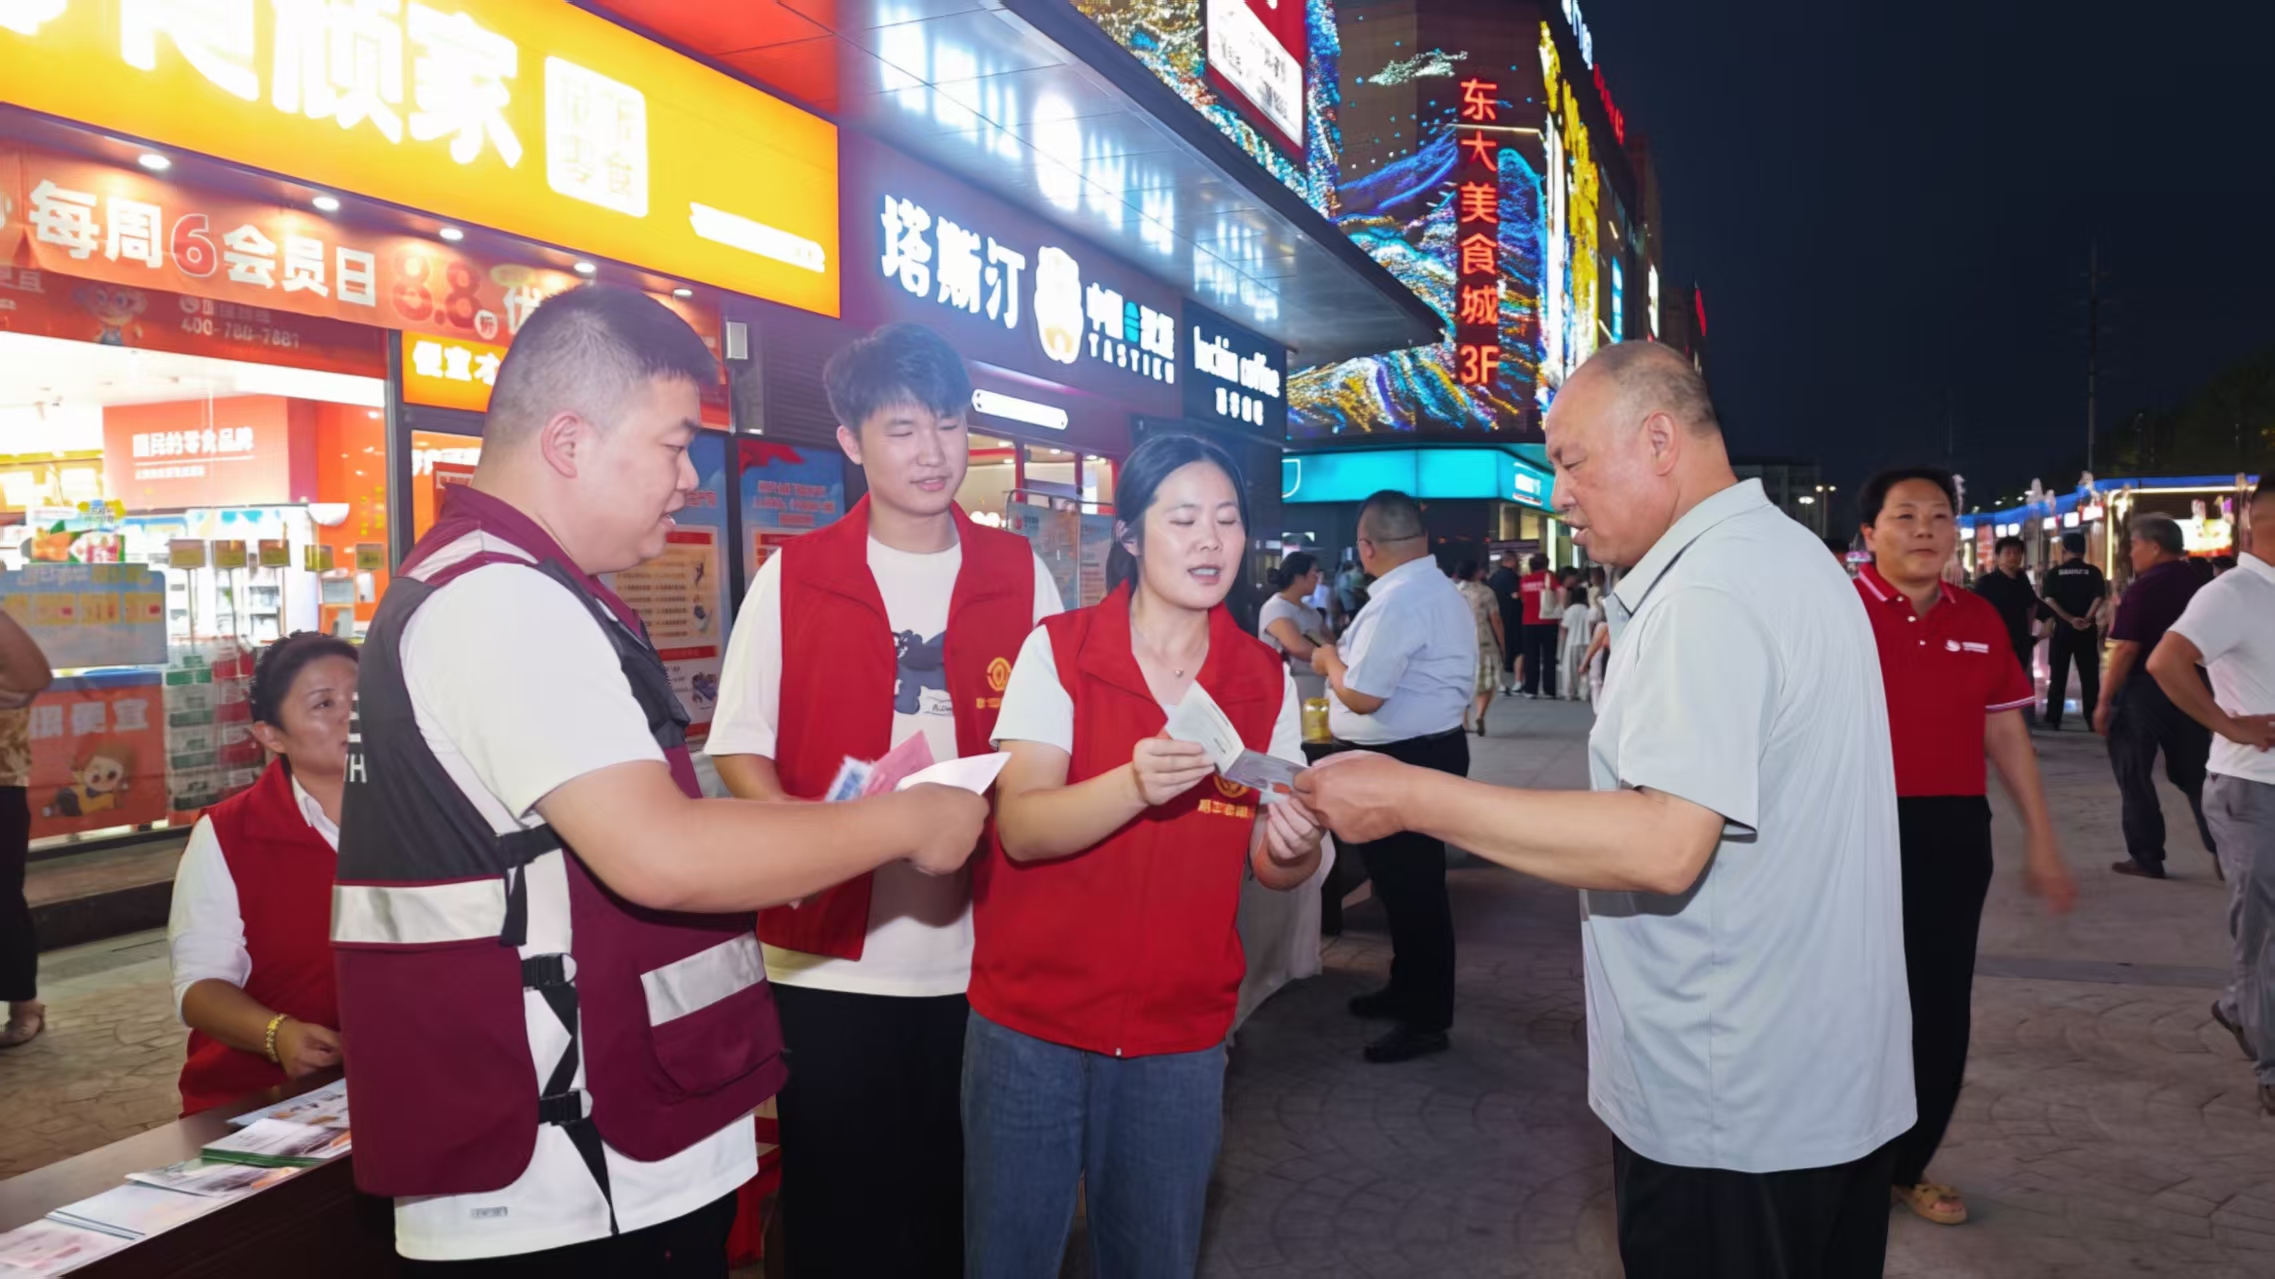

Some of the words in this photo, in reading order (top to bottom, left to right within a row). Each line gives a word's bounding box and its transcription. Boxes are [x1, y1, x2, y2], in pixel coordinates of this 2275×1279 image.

[29, 179, 377, 308] 每周6会员日
[881, 195, 1026, 329] 塔斯汀
[1460, 78, 1498, 326] 东大美食城
[1459, 344, 1500, 385] 3F
